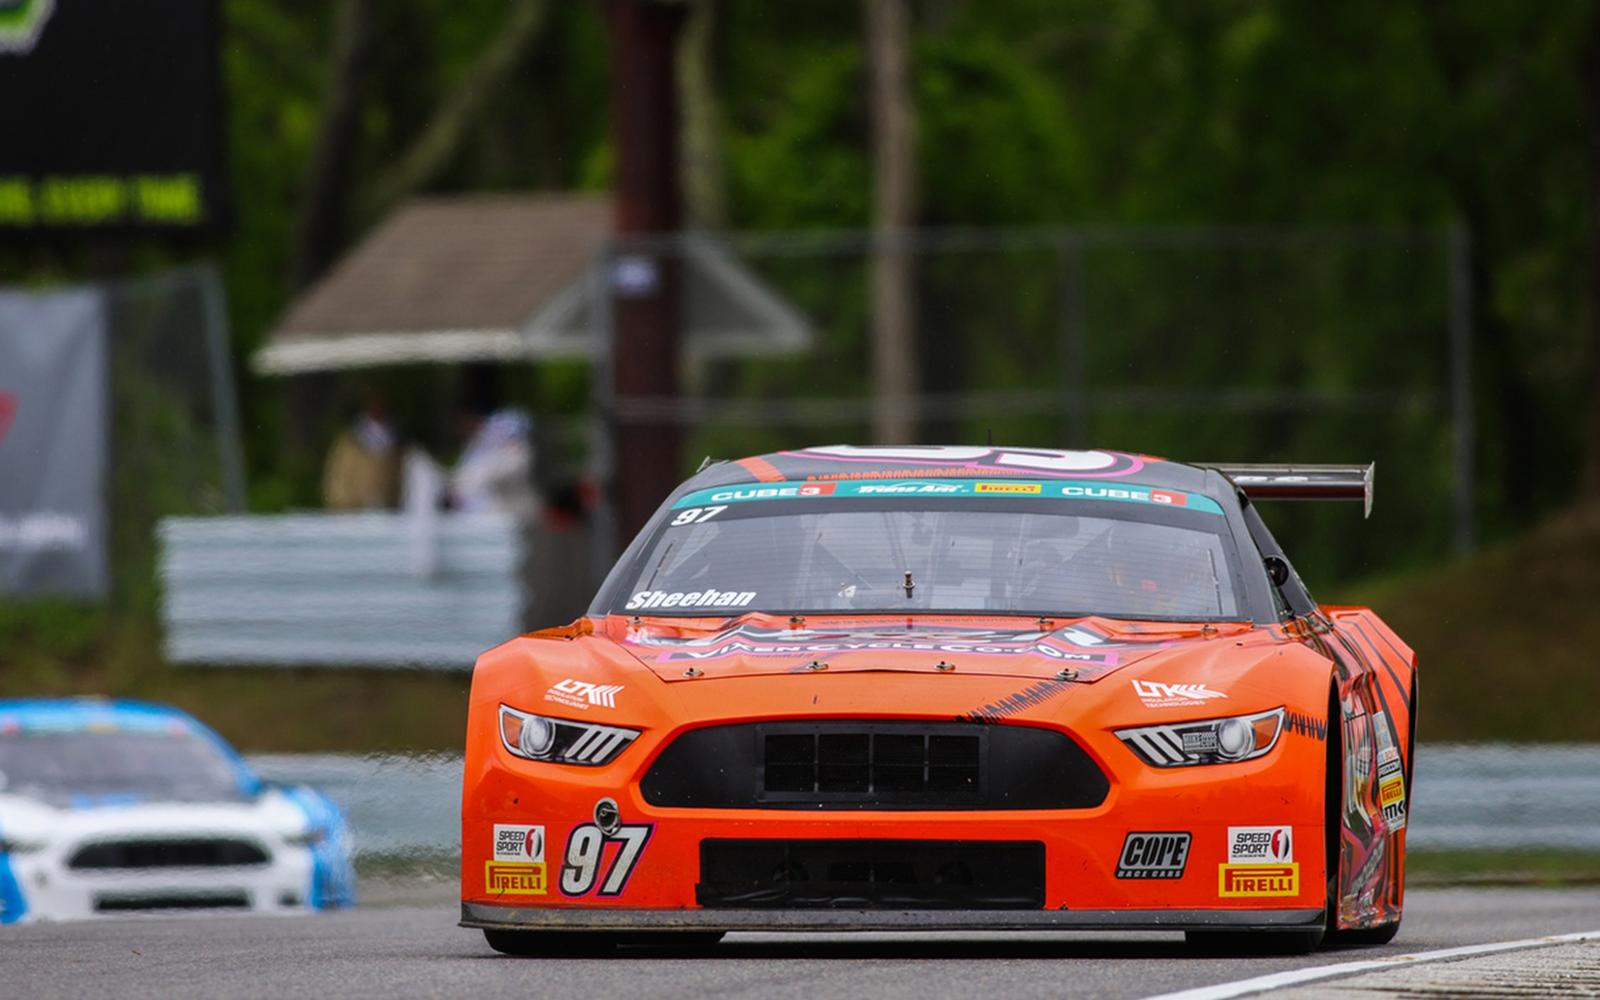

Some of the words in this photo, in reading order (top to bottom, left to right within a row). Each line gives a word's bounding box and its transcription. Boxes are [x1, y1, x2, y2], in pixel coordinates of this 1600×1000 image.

[711, 486, 821, 501] CUBE3
[1061, 486, 1172, 504] CUBE3
[671, 505, 728, 526] 97
[625, 589, 757, 609] Sheehan
[499, 831, 526, 841] SPEED
[1236, 832, 1271, 843] SPEED
[496, 841, 524, 852] SPORT
[1124, 836, 1188, 867] COPE
[1232, 843, 1270, 854] SPORT
[559, 823, 654, 896] 97
[488, 865, 542, 890] PIRELLI
[1118, 870, 1148, 878] RACE
[1152, 870, 1182, 878] CARS
[1224, 867, 1293, 892] PIRELLI
